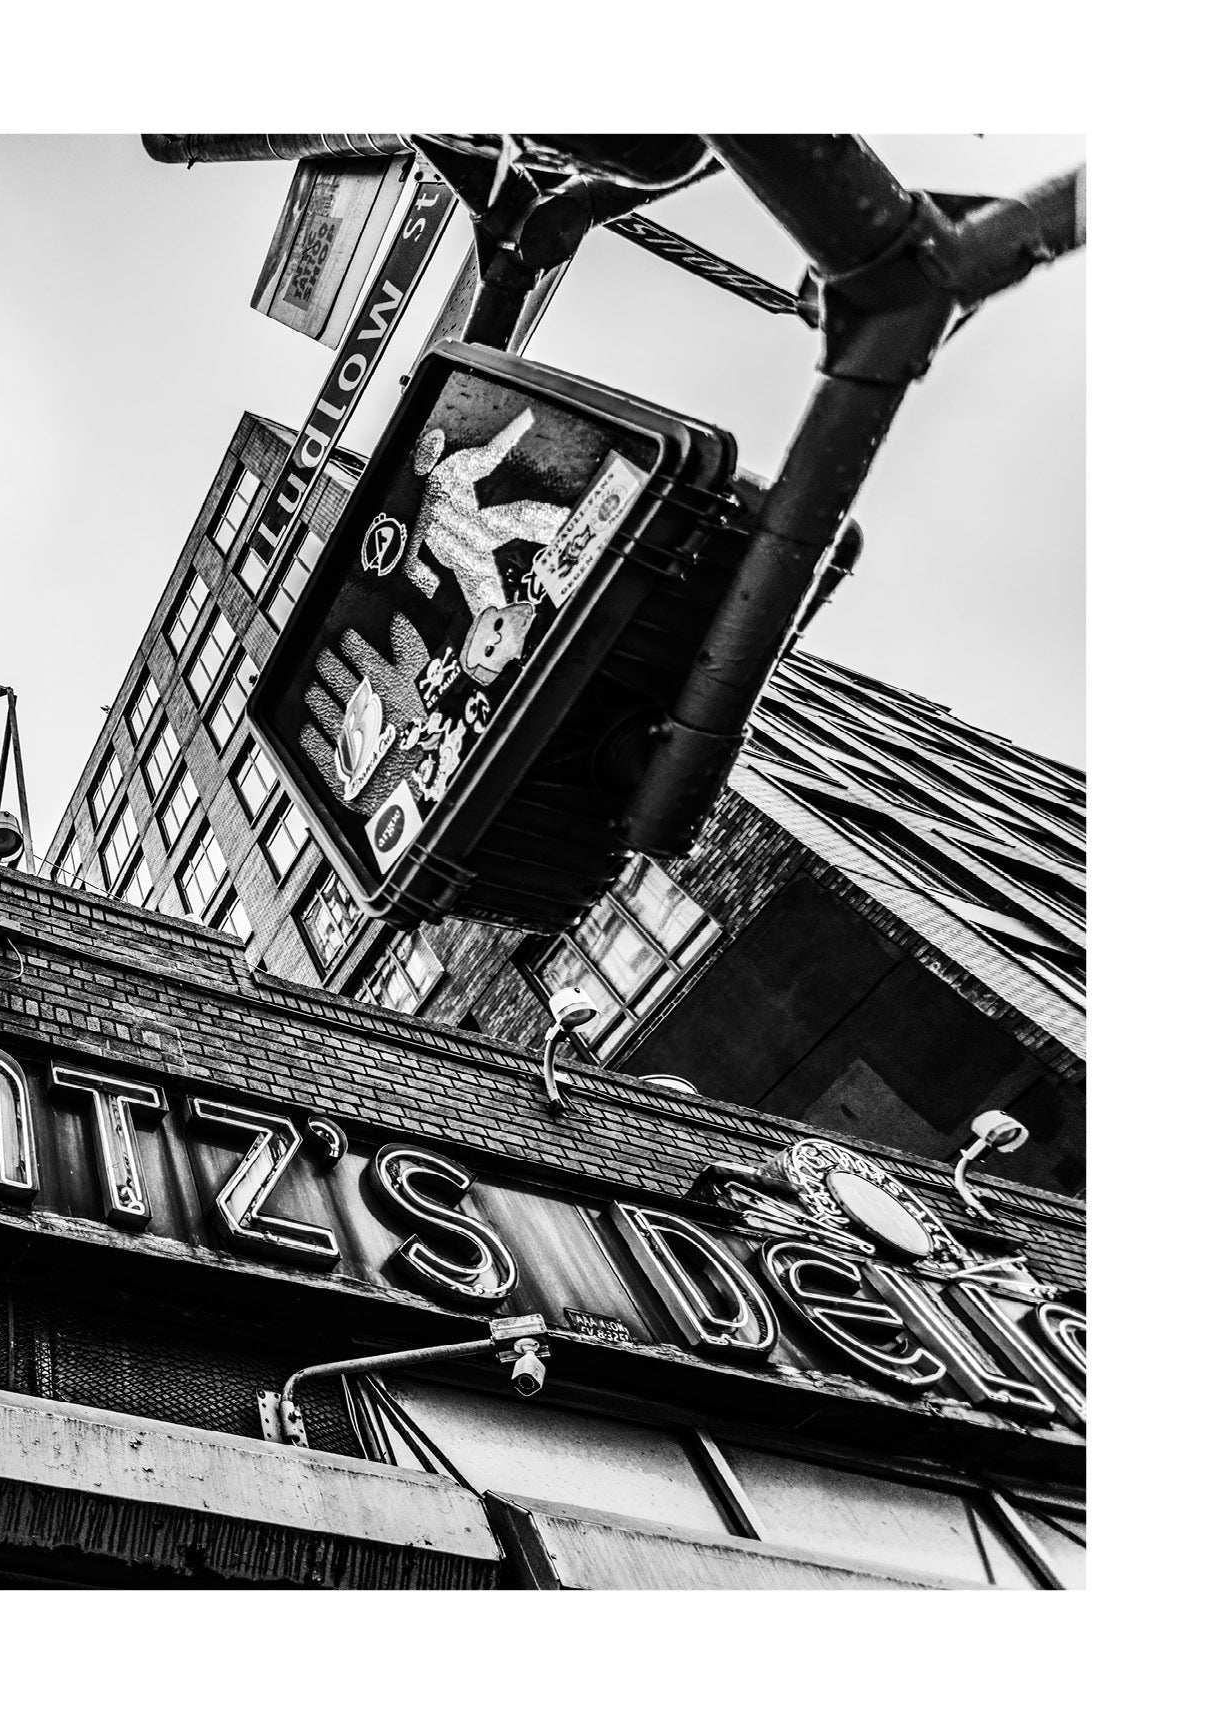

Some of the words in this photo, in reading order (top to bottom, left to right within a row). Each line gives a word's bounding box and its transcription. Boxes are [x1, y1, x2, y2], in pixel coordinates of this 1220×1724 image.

[293, 222, 329, 298] TATTOO
[302, 223, 336, 301] SHOP
[616, 221, 771, 290] Hous
[256, 280, 404, 550] Ludlow
[402, 191, 440, 242] St
